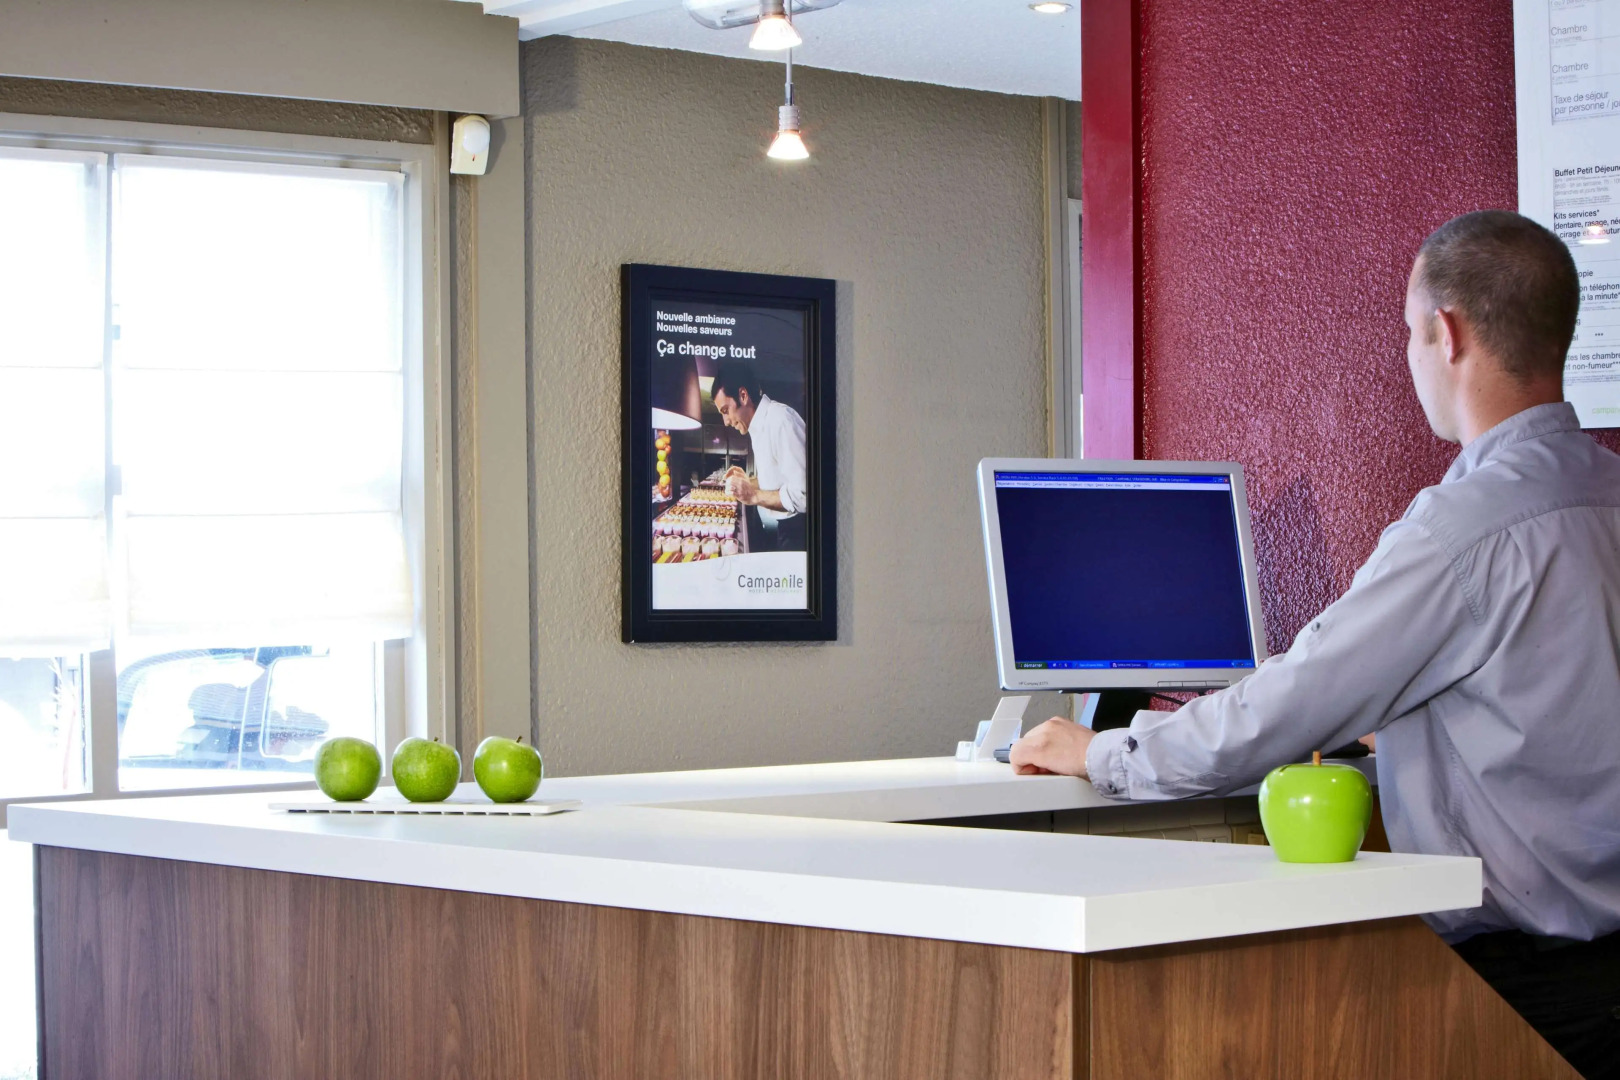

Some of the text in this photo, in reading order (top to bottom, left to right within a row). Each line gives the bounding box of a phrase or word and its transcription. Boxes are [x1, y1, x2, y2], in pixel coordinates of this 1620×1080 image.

[1551, 24, 1587, 36] Chambre
[1552, 62, 1589, 73] Chambre
[1554, 91, 1609, 104] Taxe de séjour
[1554, 106, 1567, 116] par
[1568, 102, 1605, 115] personne
[1554, 169, 1575, 177] Buffet
[1577, 167, 1593, 175] Petit
[1559, 230, 1581, 239] cirage
[1587, 293, 1593, 301] la
[656, 311, 736, 325] Nouvelle ambiance
[656, 322, 733, 336] Nouvelles saveurs
[656, 339, 756, 360] Ça change tout
[737, 574, 804, 593] Campanile
